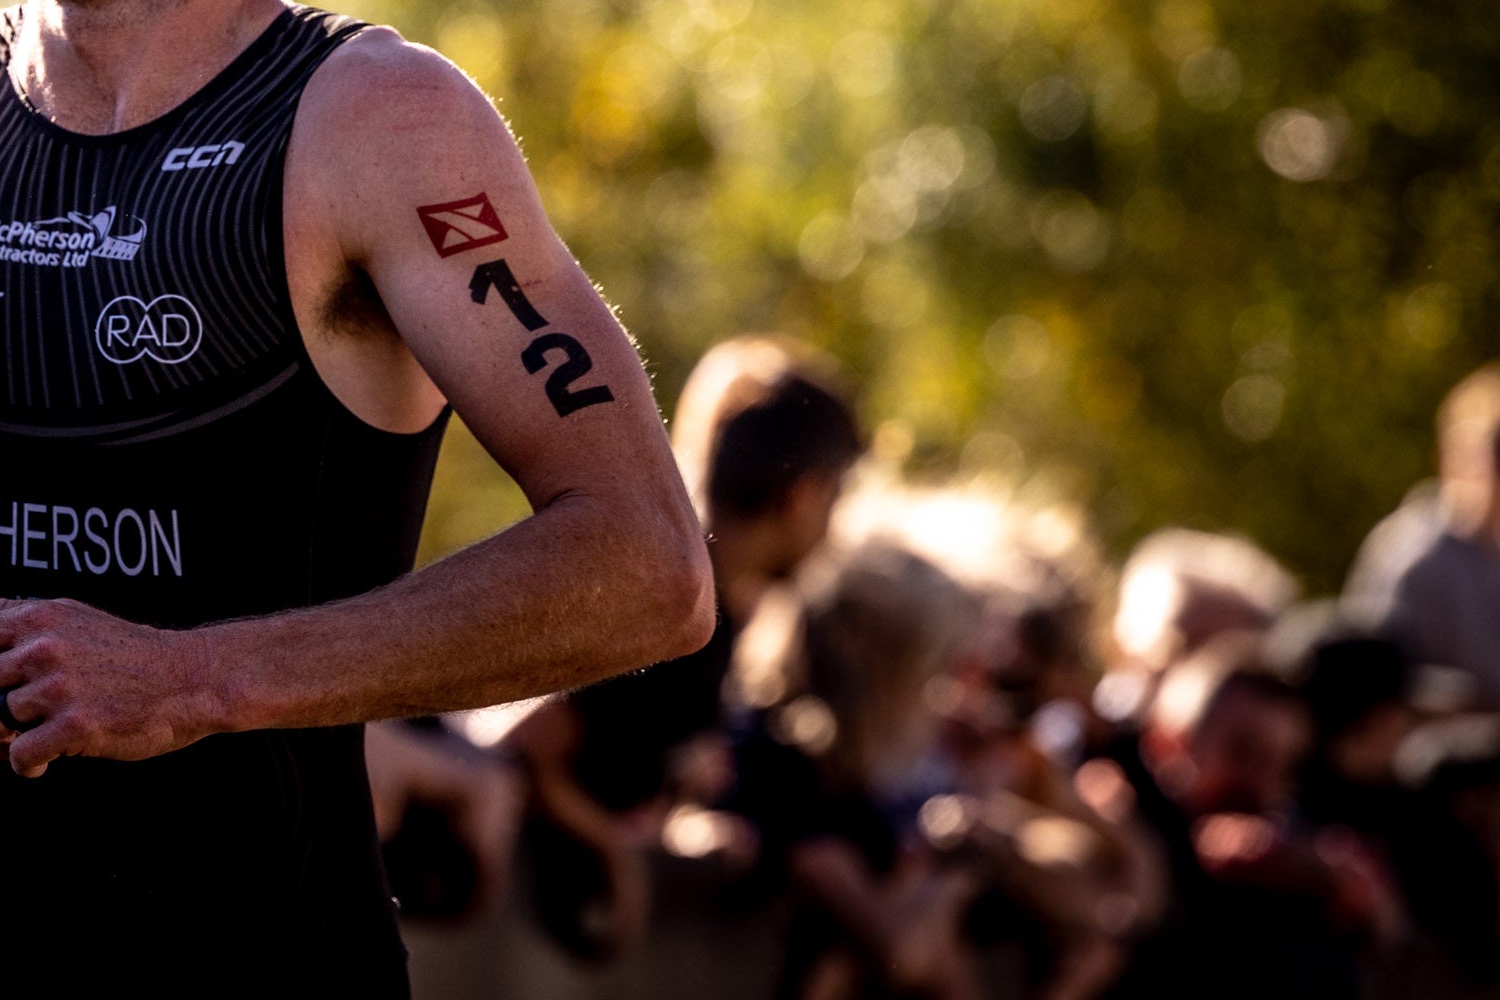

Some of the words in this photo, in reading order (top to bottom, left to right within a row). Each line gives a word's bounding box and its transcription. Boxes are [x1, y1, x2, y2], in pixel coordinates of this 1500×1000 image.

[62, 249, 88, 268] Ltd
[106, 313, 191, 348] RAD
[468, 258, 616, 418] 12
